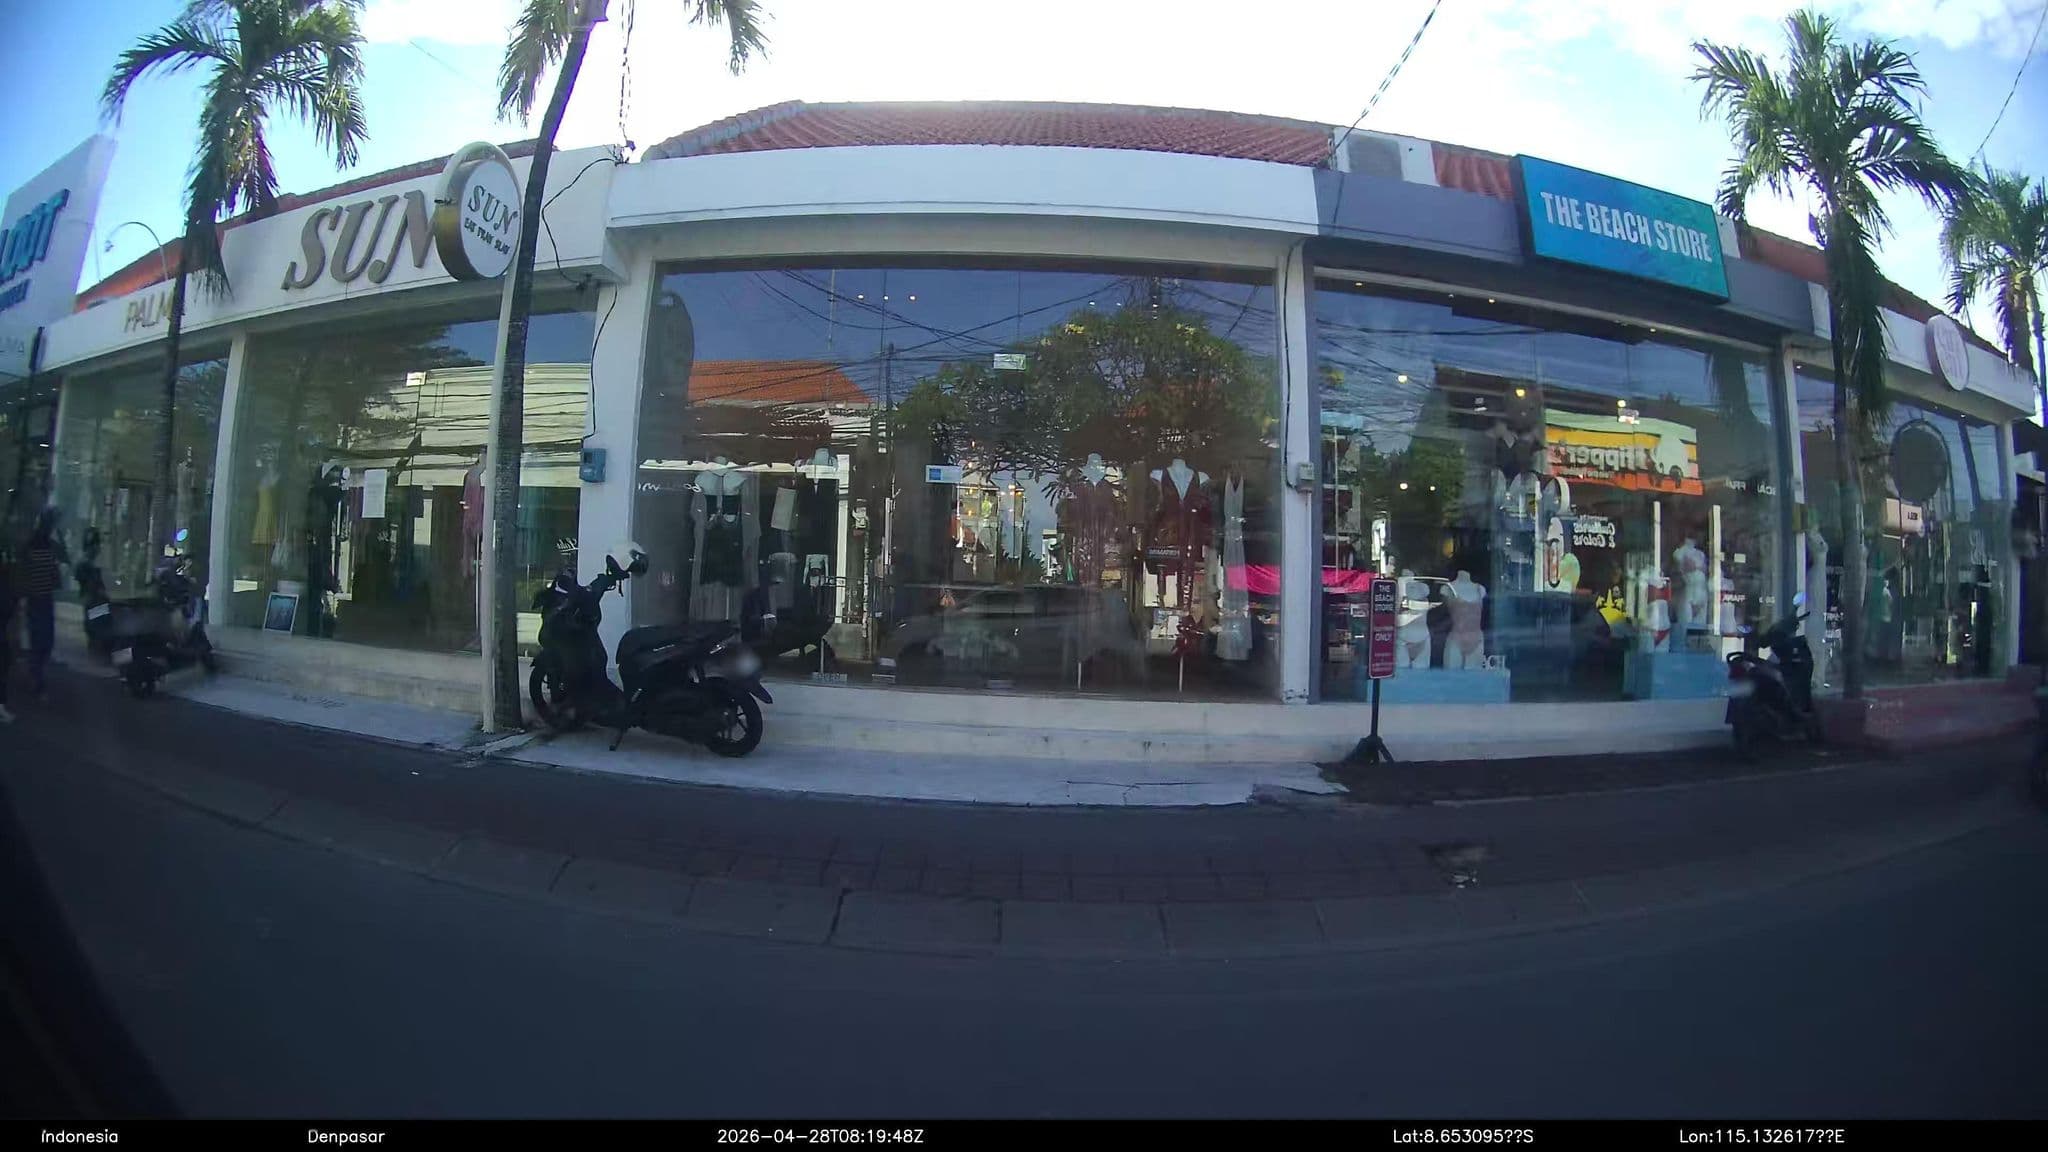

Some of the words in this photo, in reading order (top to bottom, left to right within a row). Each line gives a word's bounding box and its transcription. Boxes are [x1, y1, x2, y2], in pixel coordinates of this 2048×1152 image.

[280, 189, 438, 290] SUN
[468, 185, 518, 235] SUN
[1540, 191, 1583, 231] THE
[1585, 203, 1651, 248] BEACH
[1654, 219, 1713, 263] STORE
[1378, 585, 1391, 593] THE
